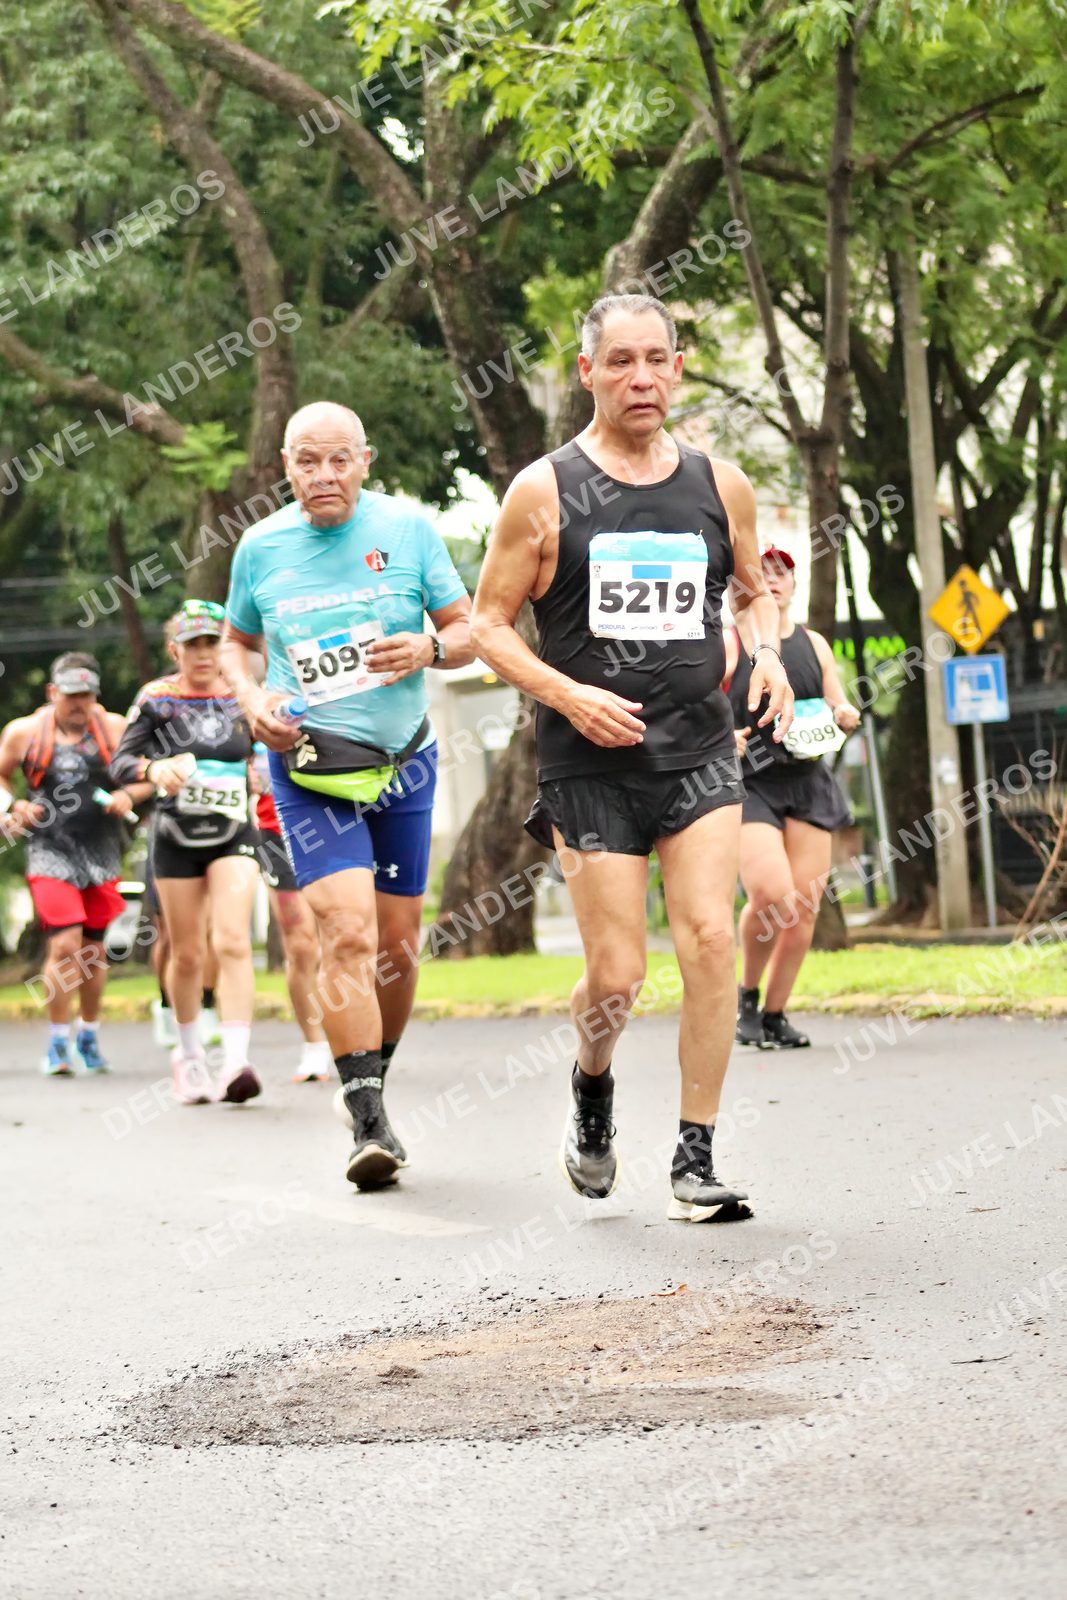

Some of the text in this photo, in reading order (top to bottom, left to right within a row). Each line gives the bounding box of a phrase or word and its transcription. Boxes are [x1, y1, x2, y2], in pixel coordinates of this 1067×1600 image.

[597, 581, 697, 614] 5219
[786, 724, 836, 747] 5089
[184, 786, 242, 808] 3525
